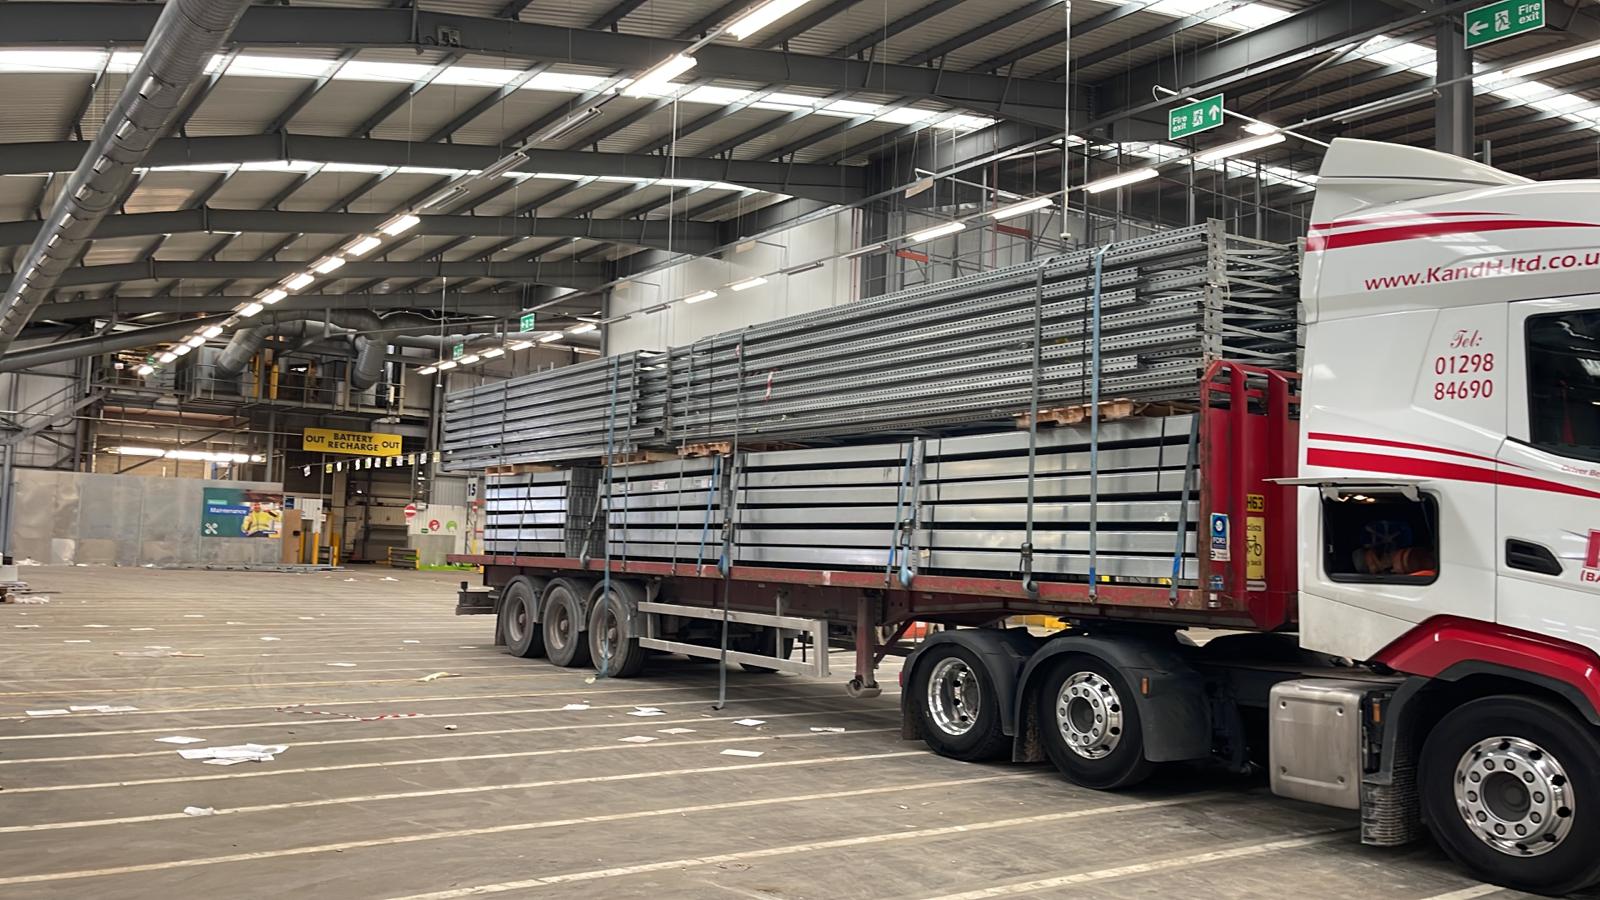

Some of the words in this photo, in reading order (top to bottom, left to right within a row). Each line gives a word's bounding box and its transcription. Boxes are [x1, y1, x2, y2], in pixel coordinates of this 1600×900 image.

[1518, 3, 1541, 15] Fire
[1519, 11, 1539, 24] exit
[1172, 116, 1187, 126] Fire
[1172, 123, 1186, 132] exit
[1449, 329, 1483, 349] Tel:
[1434, 353, 1494, 375] 01298
[1434, 379, 1493, 401] 84690
[305, 435, 325, 443] OUT
[333, 433, 373, 442] BATTERY
[328, 441, 378, 451] RECHARGE
[382, 441, 400, 449] OUT
[468, 483, 476, 496] 15
